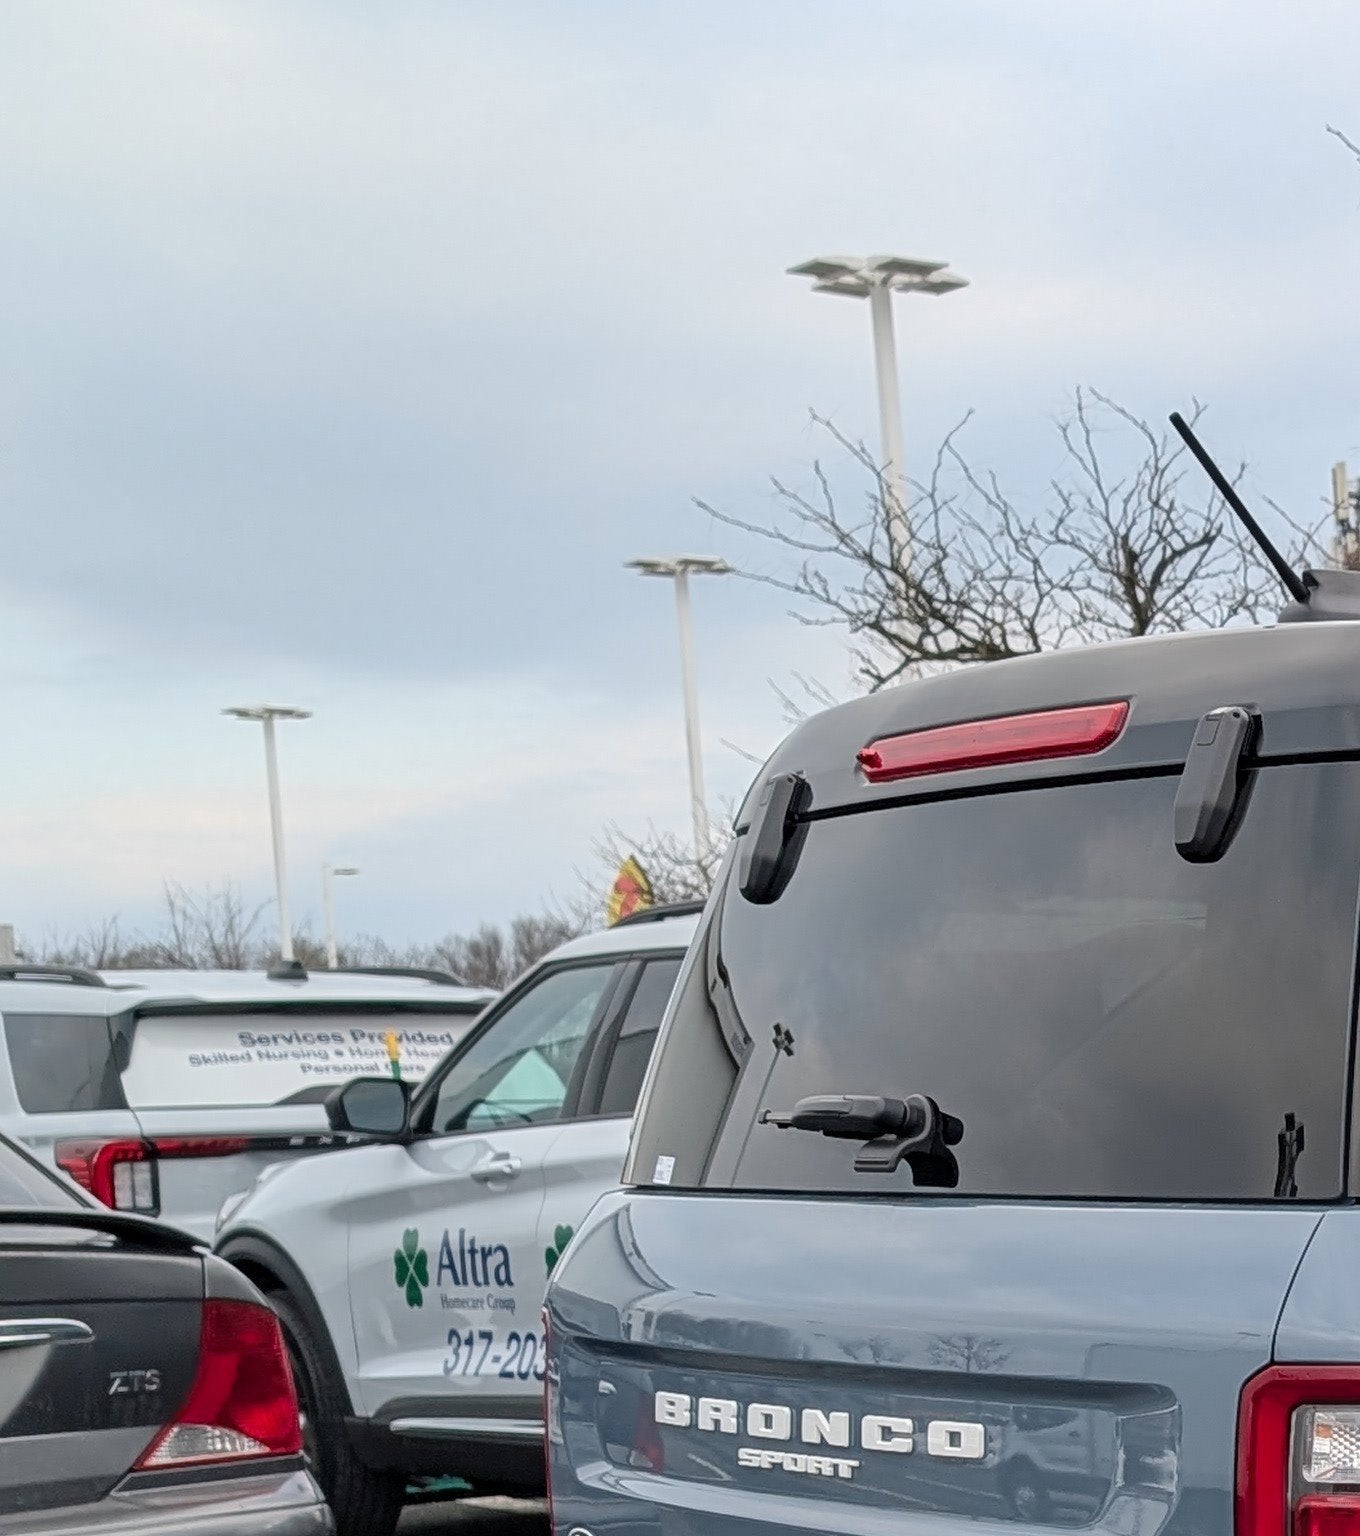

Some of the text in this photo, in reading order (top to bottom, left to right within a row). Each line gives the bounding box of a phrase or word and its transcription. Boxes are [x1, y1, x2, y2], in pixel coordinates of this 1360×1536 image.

[238, 1029, 345, 1047] Services
[188, 1051, 251, 1066] Skilled
[256, 1047, 330, 1063] Nursing
[349, 1046, 400, 1059] Hom
[300, 1060, 380, 1074] Personal
[437, 1227, 515, 1287] Altra
[440, 1293, 516, 1315] Homecare Group
[109, 1369, 160, 1395] ZTS
[654, 1390, 986, 1460] BRONCO
[737, 1447, 860, 1480] SPORT
